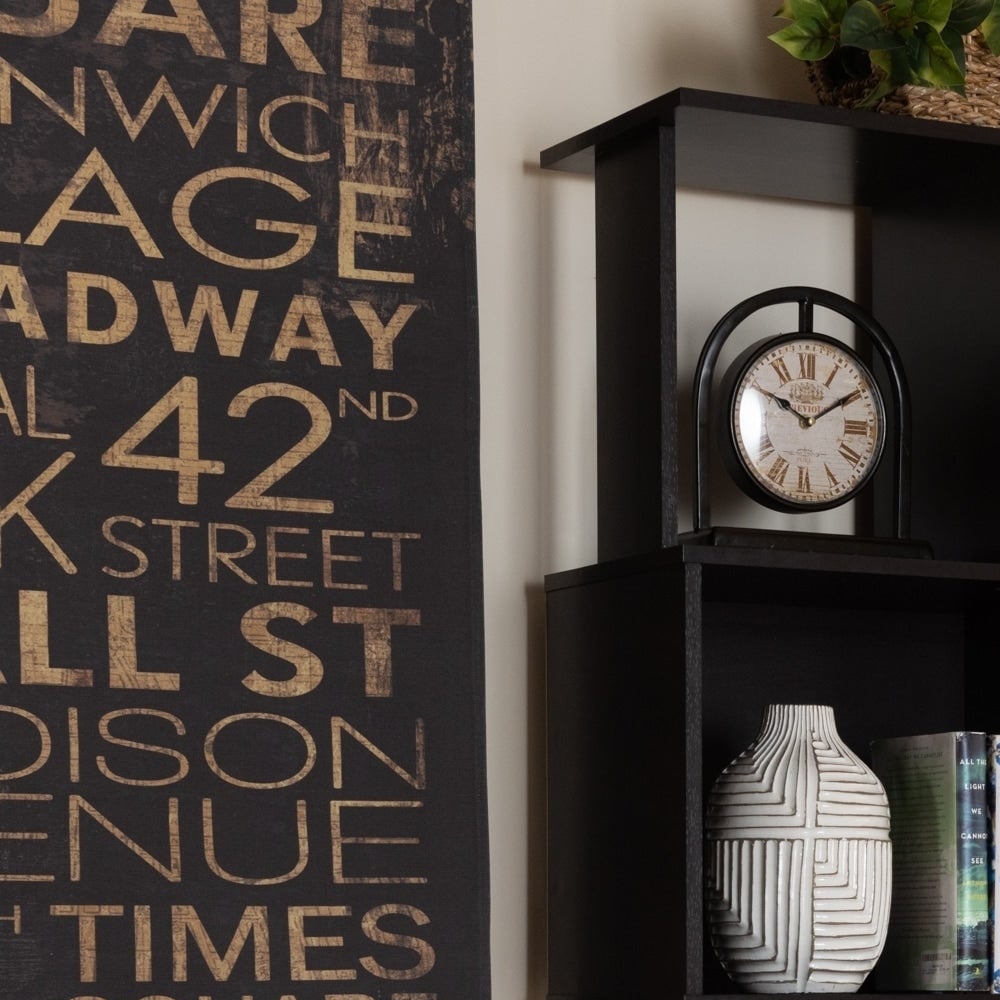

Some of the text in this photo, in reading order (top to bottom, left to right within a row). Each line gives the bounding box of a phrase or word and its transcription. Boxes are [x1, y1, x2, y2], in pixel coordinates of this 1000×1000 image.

[0, 147, 415, 284] AGE
[101, 515, 421, 591] STREET
[0, 589, 421, 698] LL ST
[50, 904, 436, 983] TIMES
